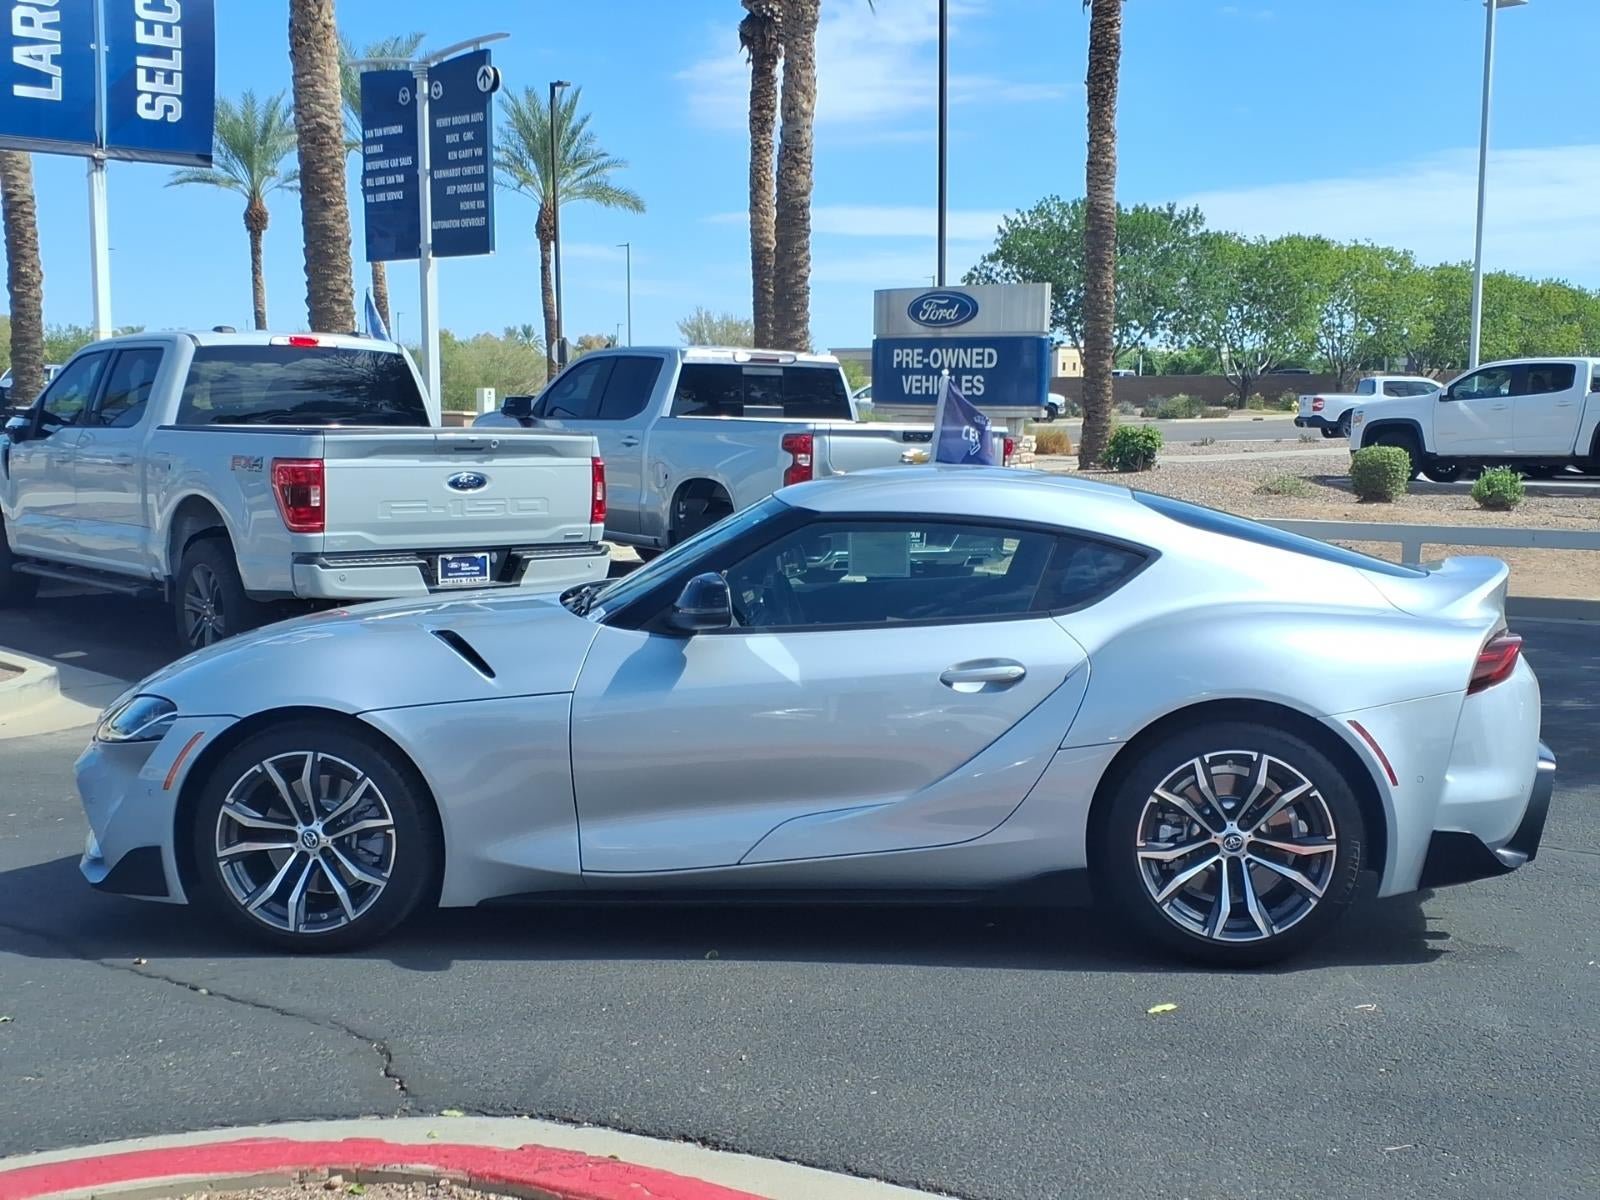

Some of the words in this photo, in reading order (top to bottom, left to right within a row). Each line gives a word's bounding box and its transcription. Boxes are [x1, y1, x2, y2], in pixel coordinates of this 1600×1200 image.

[12, 0, 62, 101] LAR
[452, 114, 470, 126] BROWN
[471, 112, 484, 122] AUTO
[365, 130, 374, 139] SAN
[374, 128, 383, 137] TAN
[463, 131, 474, 141] GMC
[365, 144, 384, 155] CARMAX
[474, 147, 483, 157] VW
[366, 160, 390, 171] ENTERPRISE
[390, 158, 399, 168] CAR
[400, 156, 412, 167] SALES
[462, 165, 484, 176] CHRYSLER
[386, 175, 395, 185] SAN
[446, 185, 456, 195] JEEP
[457, 184, 473, 194] DODGE
[386, 190, 404, 201] SERVICE
[477, 200, 485, 209] KIA
[461, 216, 486, 228] CHEVROLET
[919, 299, 960, 321] Ford
[893, 347, 998, 369] PRE-OWNED
[231, 455, 264, 471] FX4
[377, 497, 550, 520] F-150
